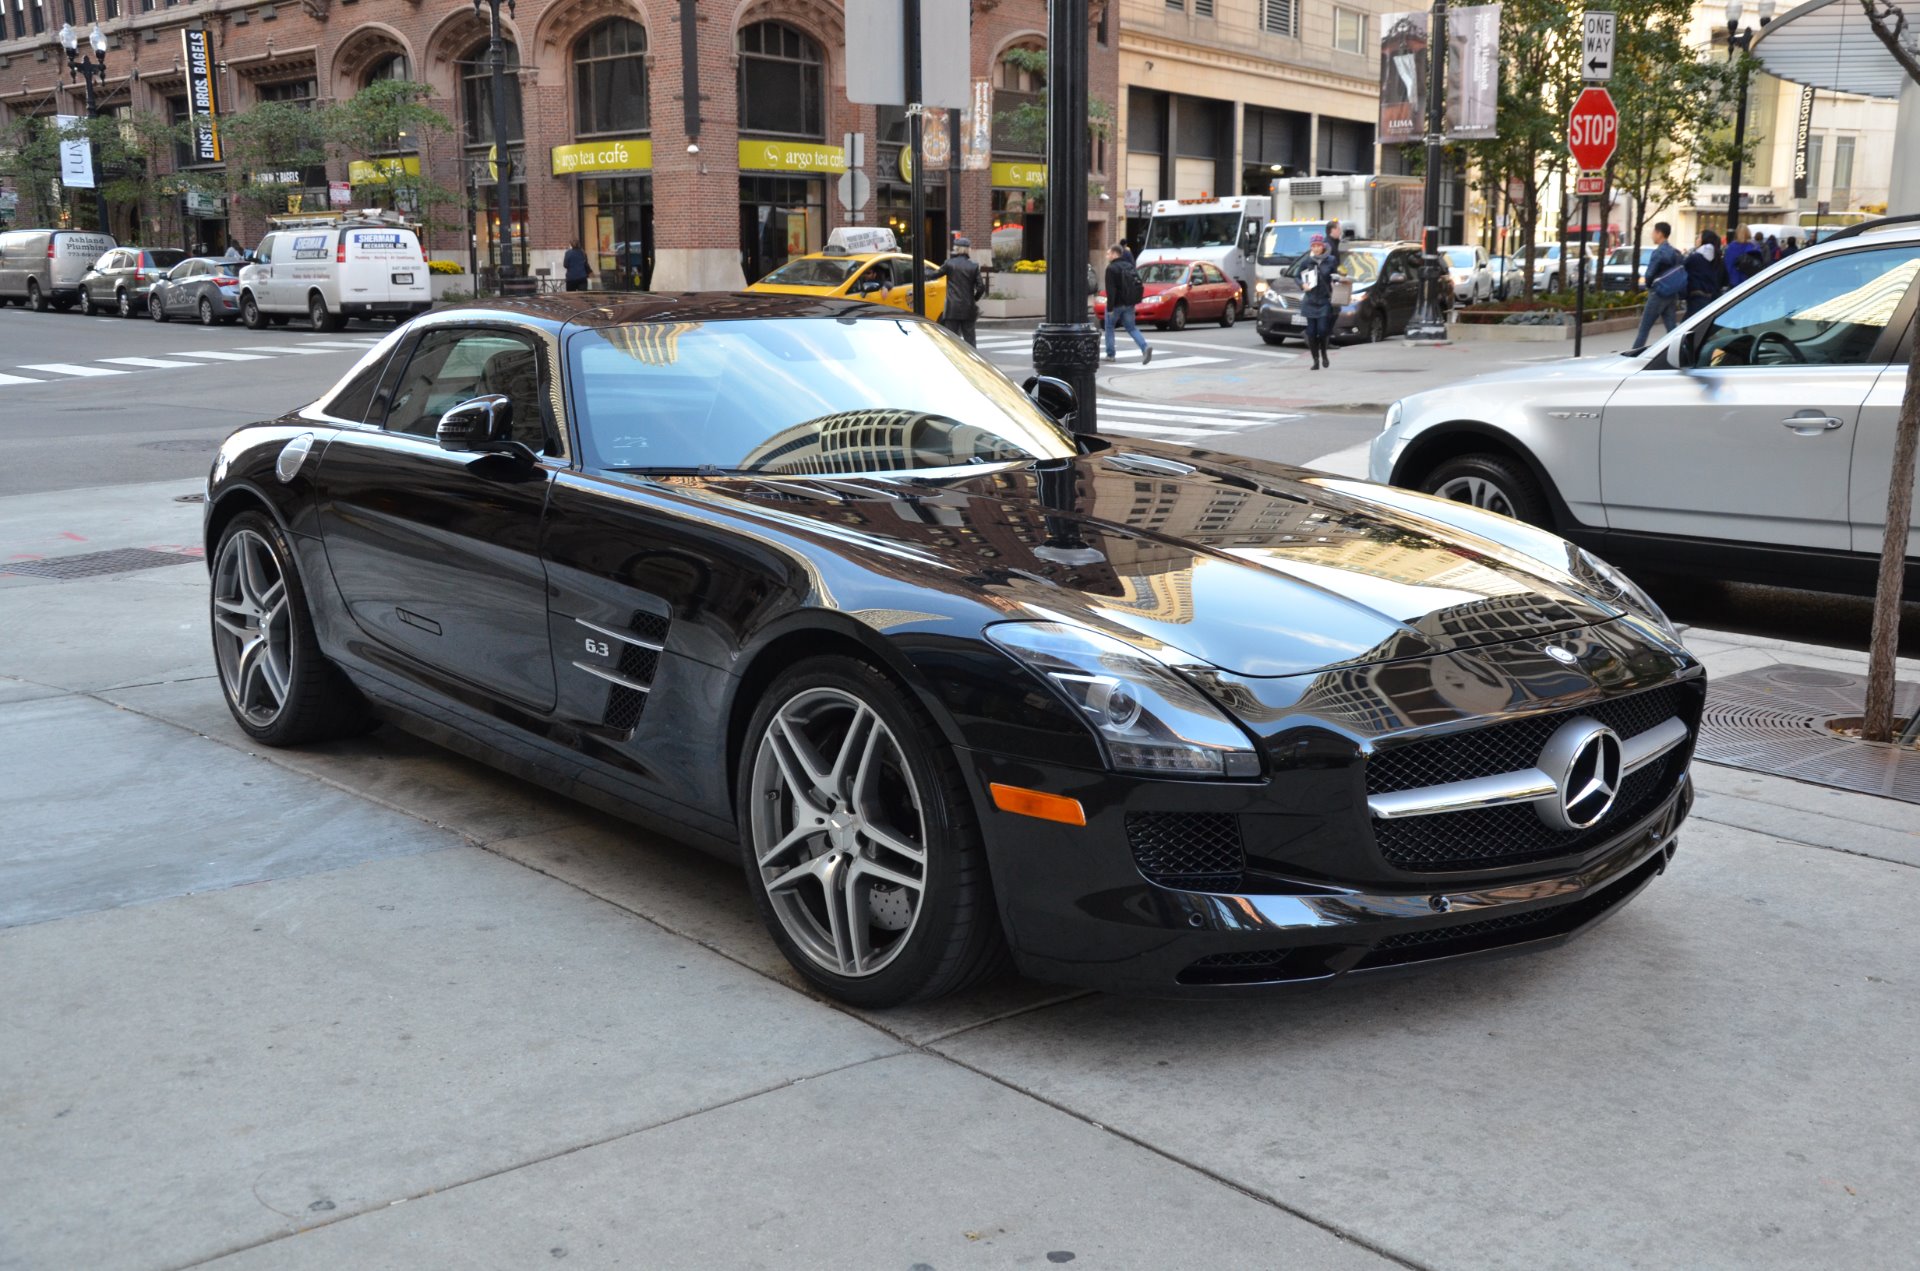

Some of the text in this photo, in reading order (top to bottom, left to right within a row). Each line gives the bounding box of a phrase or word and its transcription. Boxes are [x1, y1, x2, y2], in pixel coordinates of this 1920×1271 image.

[1588, 18, 1611, 35] ONE
[190, 32, 206, 75] BAGELS
[1587, 37, 1611, 53] WAY
[195, 79, 210, 107] BROS.
[1389, 119, 1413, 128] LUMA
[1572, 115, 1614, 145] STOP
[580, 150, 595, 165] tea
[598, 142, 629, 164] café
[786, 151, 812, 169] argo
[815, 151, 828, 165] tea
[1795, 152, 1807, 180] rack
[280, 171, 299, 183] BAGELS
[1579, 180, 1602, 191] ALL WAY
[1756, 191, 1775, 205] rack
[66, 243, 108, 251] Plumbing
[359, 234, 396, 243] SHERMAN
[585, 638, 609, 657] 6.3
